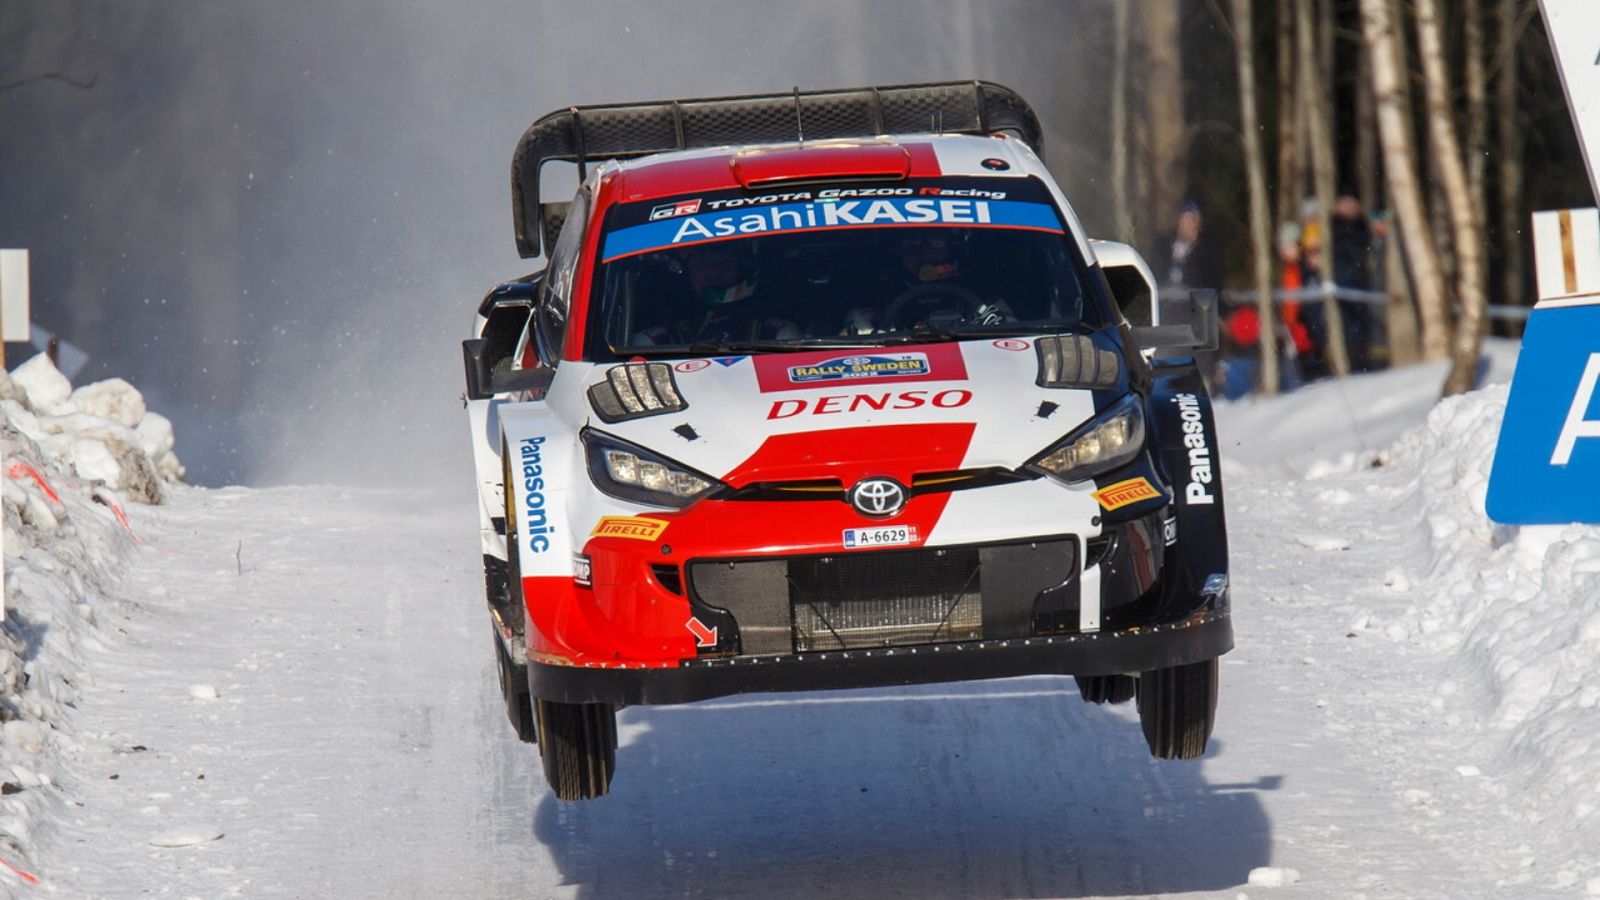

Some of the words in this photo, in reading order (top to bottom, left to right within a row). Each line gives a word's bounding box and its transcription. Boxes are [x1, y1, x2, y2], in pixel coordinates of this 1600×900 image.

[707, 192, 812, 209] TOYOTA
[819, 187, 913, 199] GAZOO
[919, 187, 1007, 200] Racing
[652, 204, 698, 219] GR
[795, 366, 845, 376] RALLY
[851, 360, 921, 372] SWEDEN
[766, 389, 973, 421] DENSO
[1171, 393, 1215, 505] Panasonic
[520, 436, 555, 553] Panasonic
[1097, 481, 1154, 506] PIRELLI
[597, 520, 661, 537] PIRELLI
[861, 529, 906, 544] A-6629
